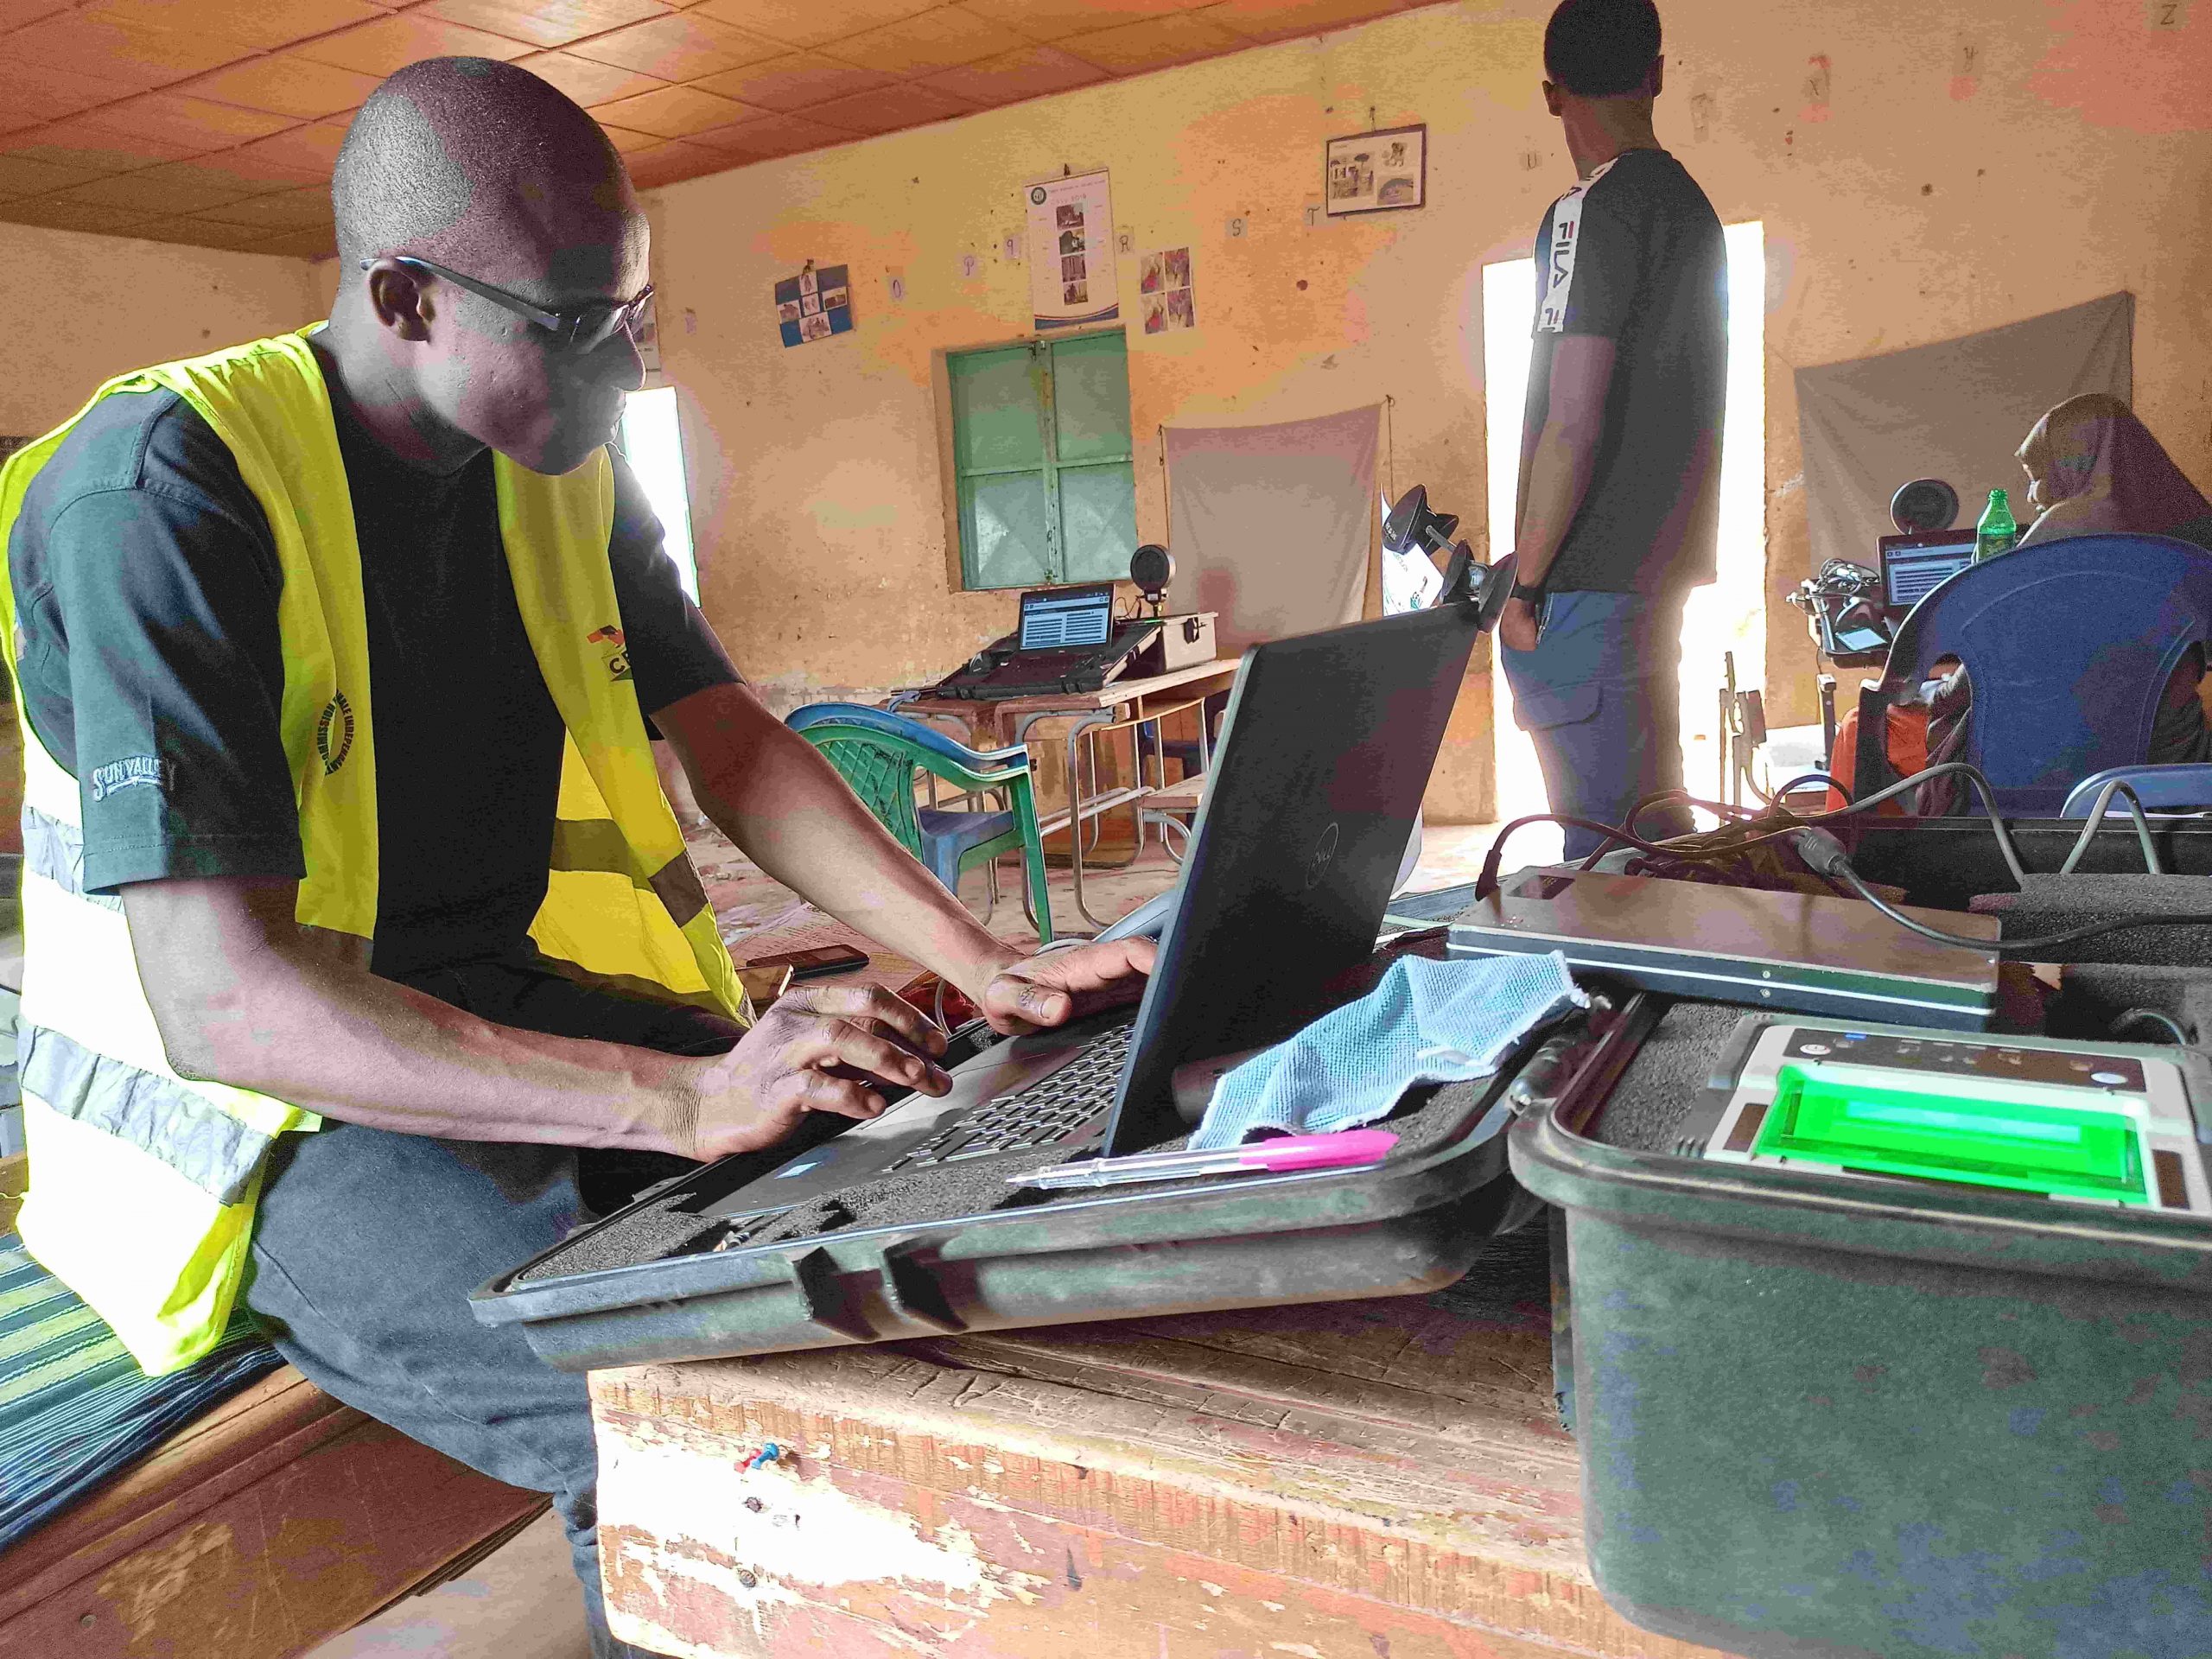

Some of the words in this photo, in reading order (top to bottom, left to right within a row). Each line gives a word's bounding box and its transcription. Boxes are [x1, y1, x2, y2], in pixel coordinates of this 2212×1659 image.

[2160, 3, 2177, 25] Z
[1527, 154, 1537, 169] U
[1306, 206, 1321, 226] T
[1231, 218, 1242, 237] S
[1119, 234, 1130, 252] R
[1554, 220, 1575, 289] FILA
[963, 256, 975, 276] P
